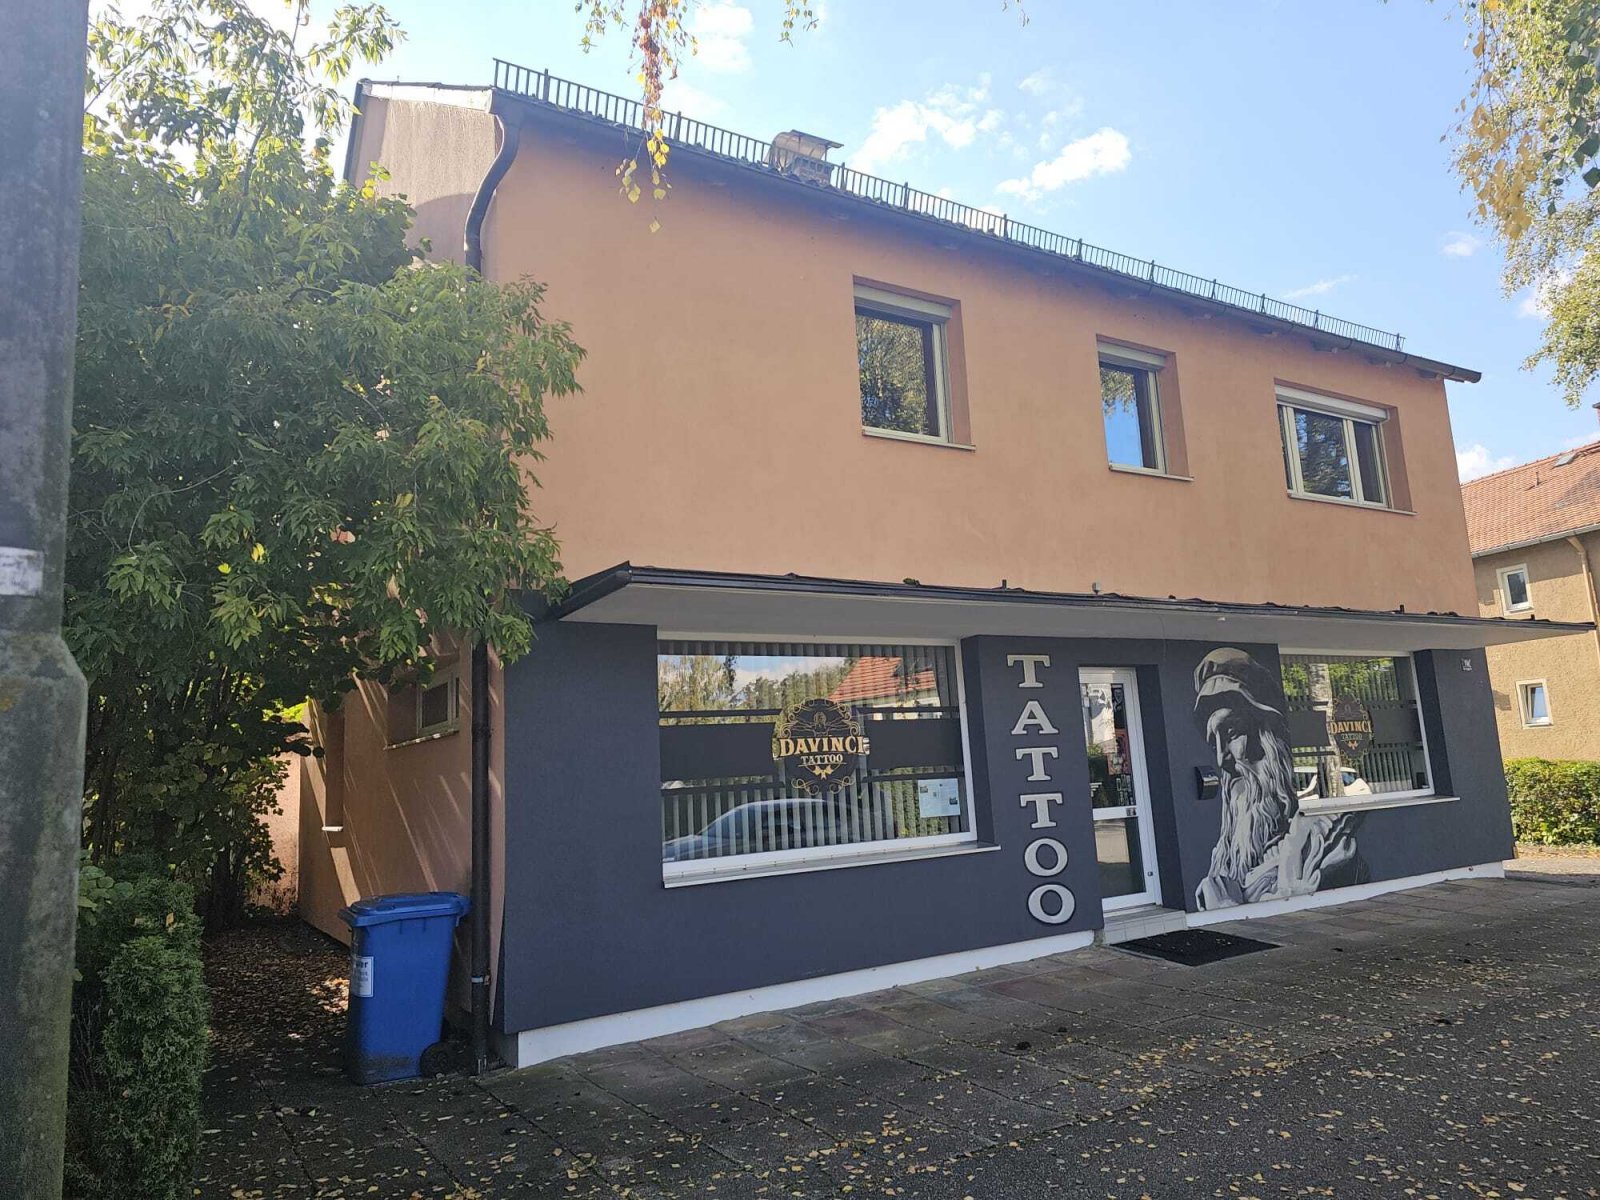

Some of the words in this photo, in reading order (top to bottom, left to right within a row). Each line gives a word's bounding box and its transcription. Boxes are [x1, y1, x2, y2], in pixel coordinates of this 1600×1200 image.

[1330, 720, 1372, 734] DAVINCI
[780, 736, 864, 757] DAVINCI
[800, 753, 843, 765] TATTOO
[1006, 654, 1075, 924] TATTOO
